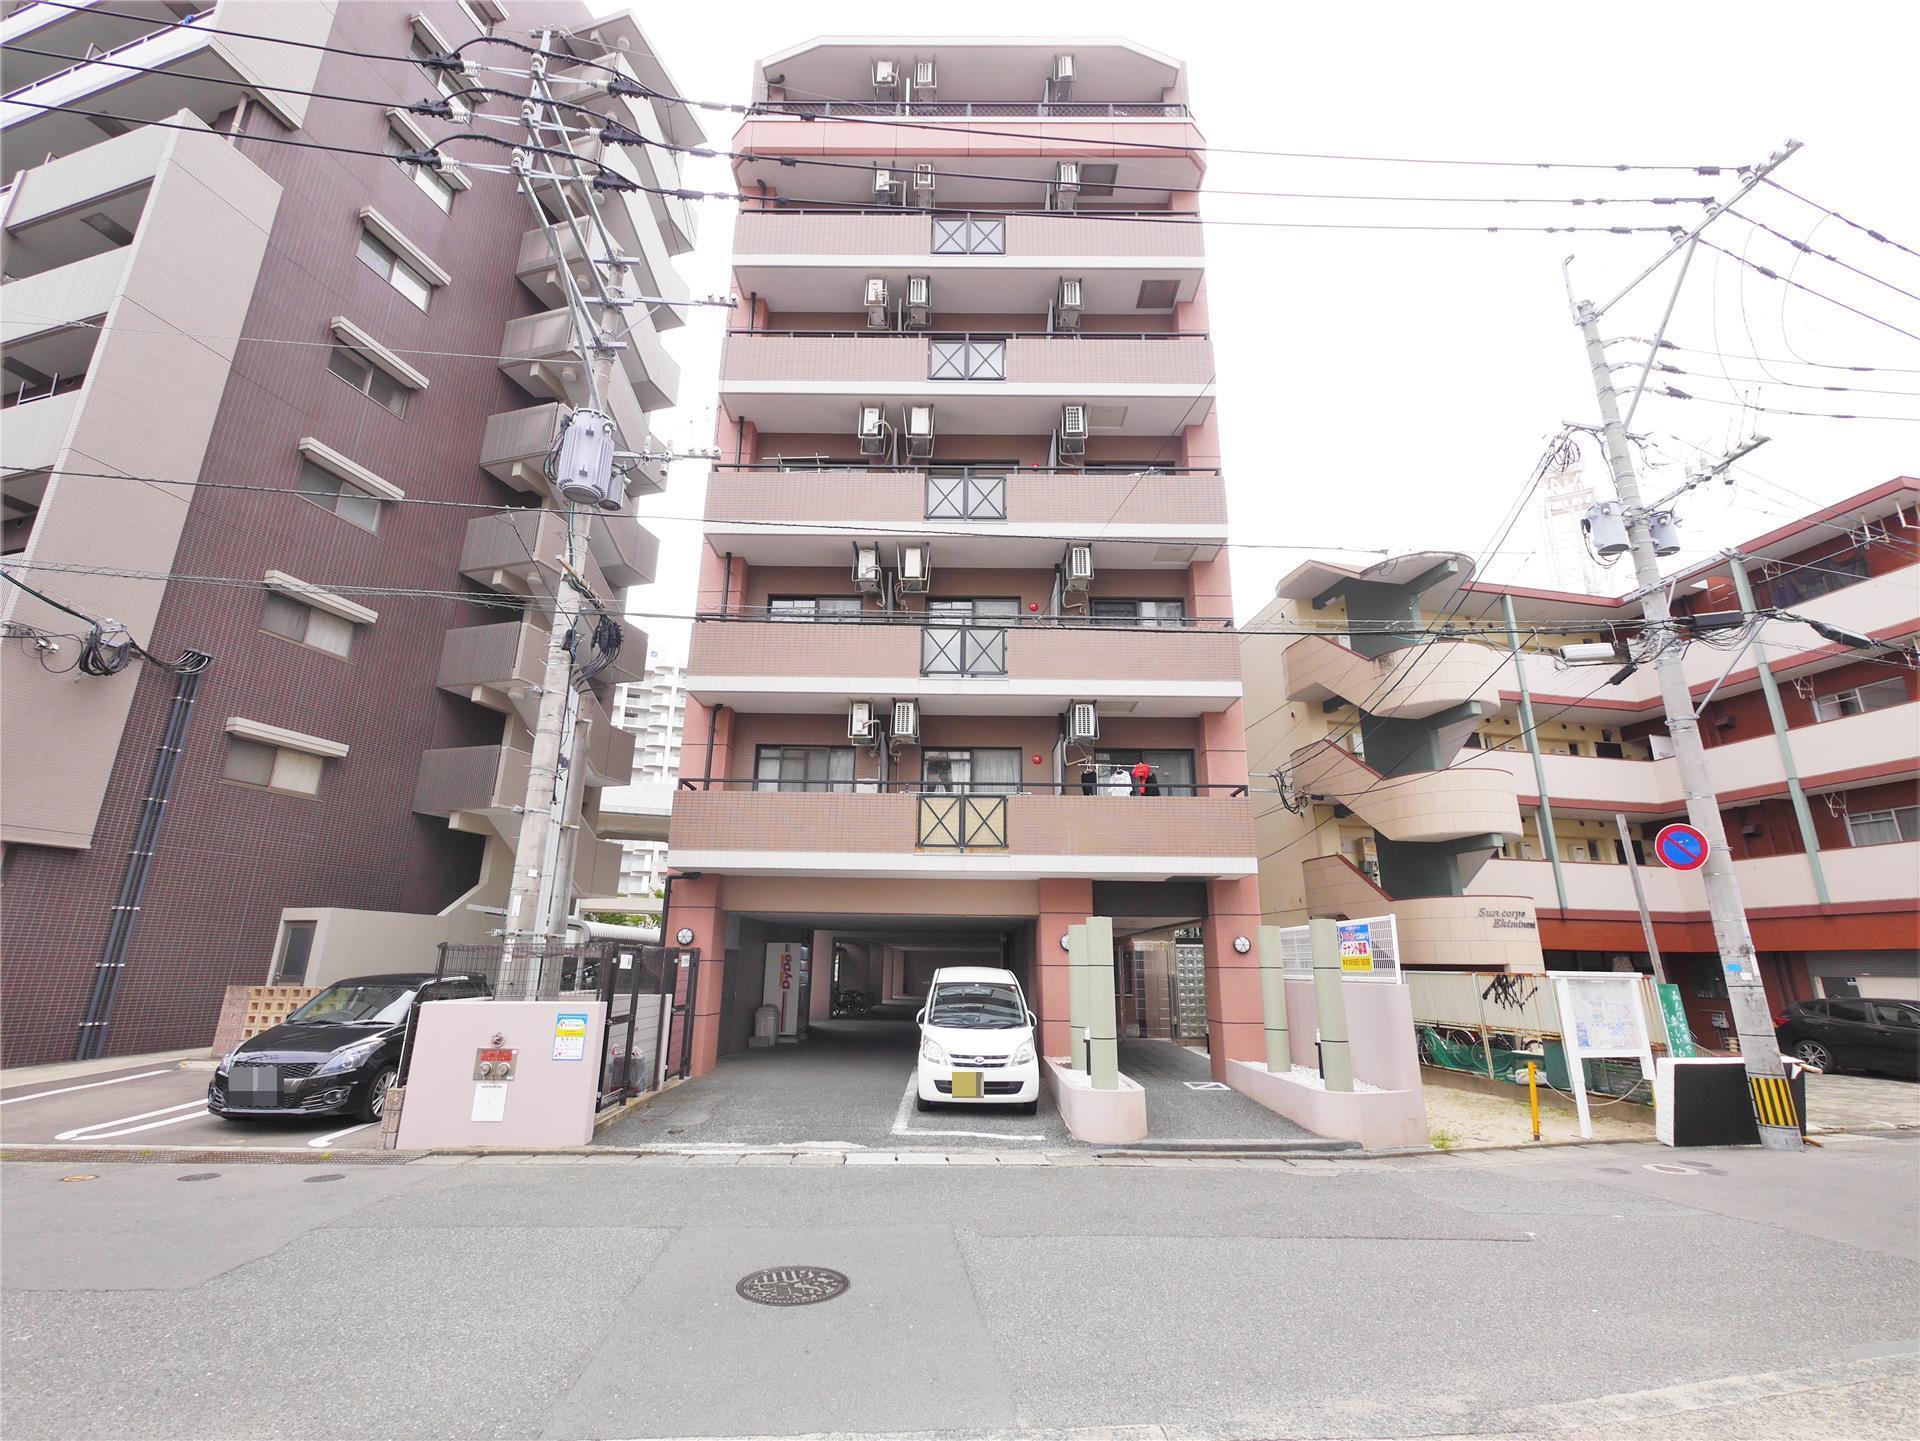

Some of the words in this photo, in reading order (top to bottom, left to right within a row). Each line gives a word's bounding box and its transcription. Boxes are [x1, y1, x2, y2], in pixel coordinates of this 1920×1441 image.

[1478, 907, 1501, 917] Sun
[1343, 942, 1368, 955] テナント募集
[782, 954, 793, 989] DyDo
